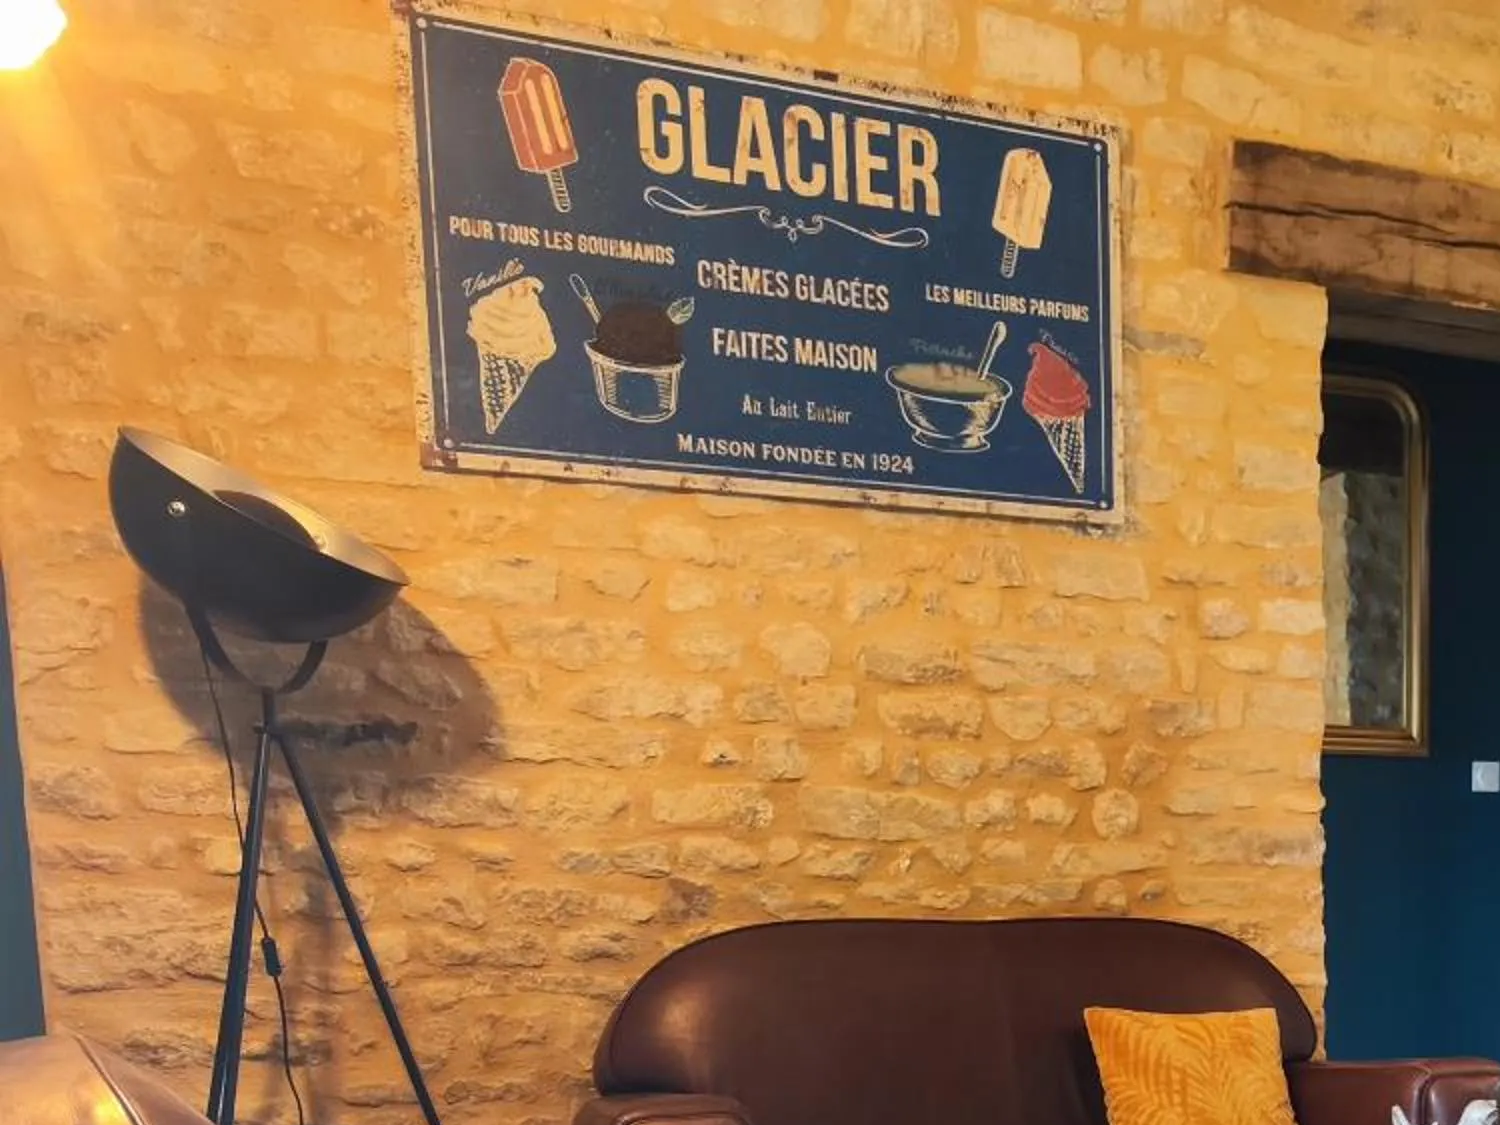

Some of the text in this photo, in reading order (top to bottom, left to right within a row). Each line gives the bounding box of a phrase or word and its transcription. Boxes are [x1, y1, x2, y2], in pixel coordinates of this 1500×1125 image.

[636, 78, 941, 217] GLACIER
[450, 215, 676, 266] POUR TOUS LES GOURMANDS
[697, 257, 789, 298] CRÈMES
[794, 273, 889, 312] GLACÉES
[925, 283, 1090, 323] LES MEILLEURS PARFUMS
[712, 327, 877, 373] FAITES MAISON
[741, 393, 852, 425] Au Lait Entier
[677, 433, 915, 475] MAISON FONDÉE EN 1924
